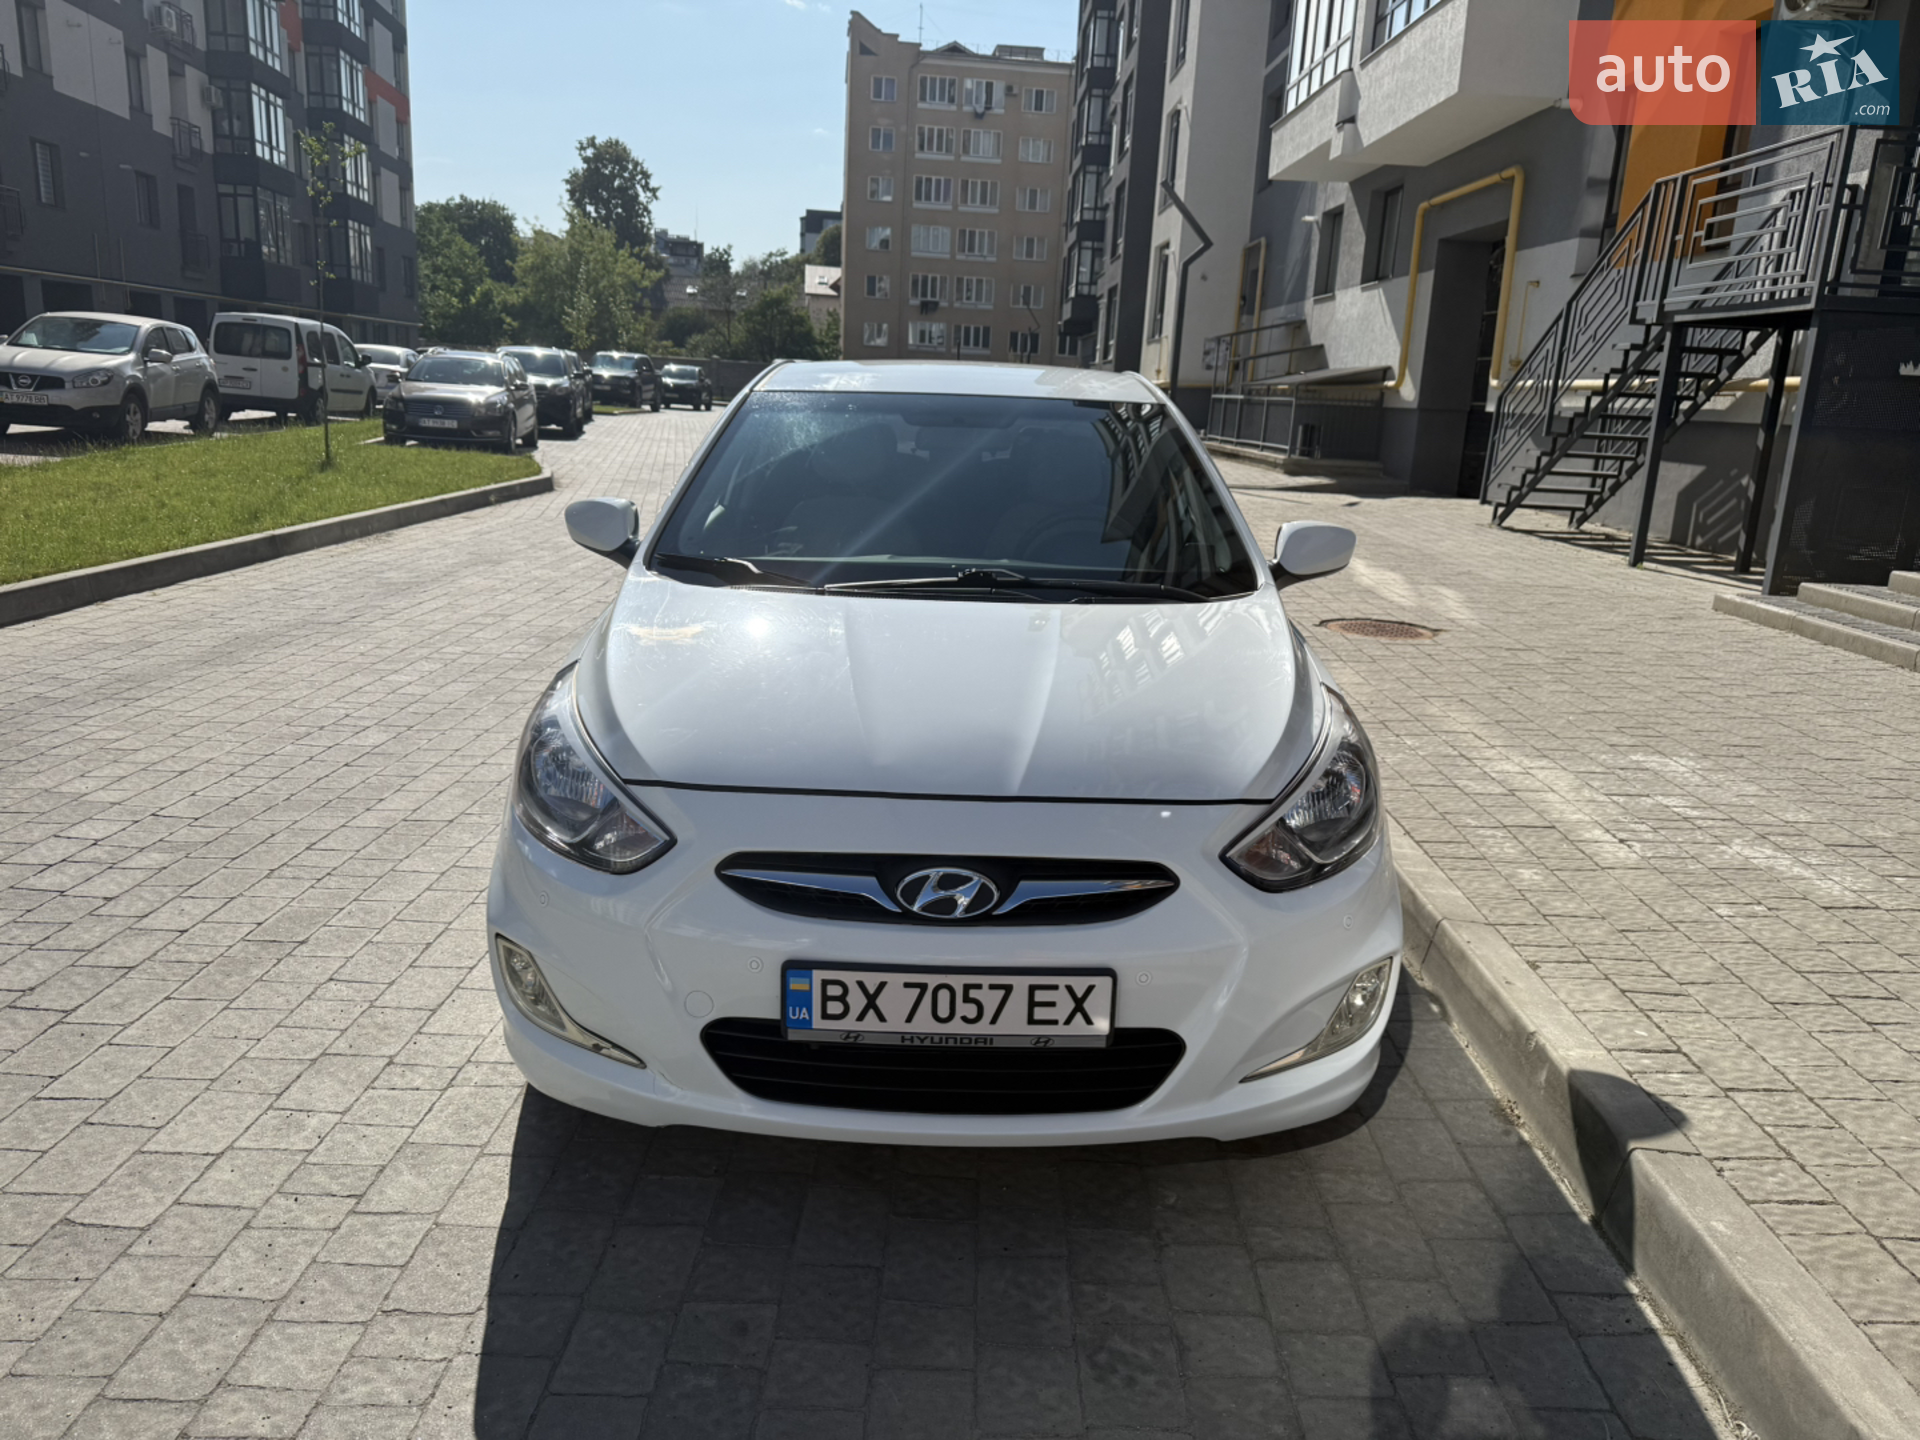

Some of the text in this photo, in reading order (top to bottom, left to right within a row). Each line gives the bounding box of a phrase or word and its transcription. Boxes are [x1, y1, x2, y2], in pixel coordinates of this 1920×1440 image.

[820, 978, 1097, 1026] BX 7057 EX
[789, 1006, 810, 1020] UA
[900, 1034, 994, 1046] HYUNDAI
